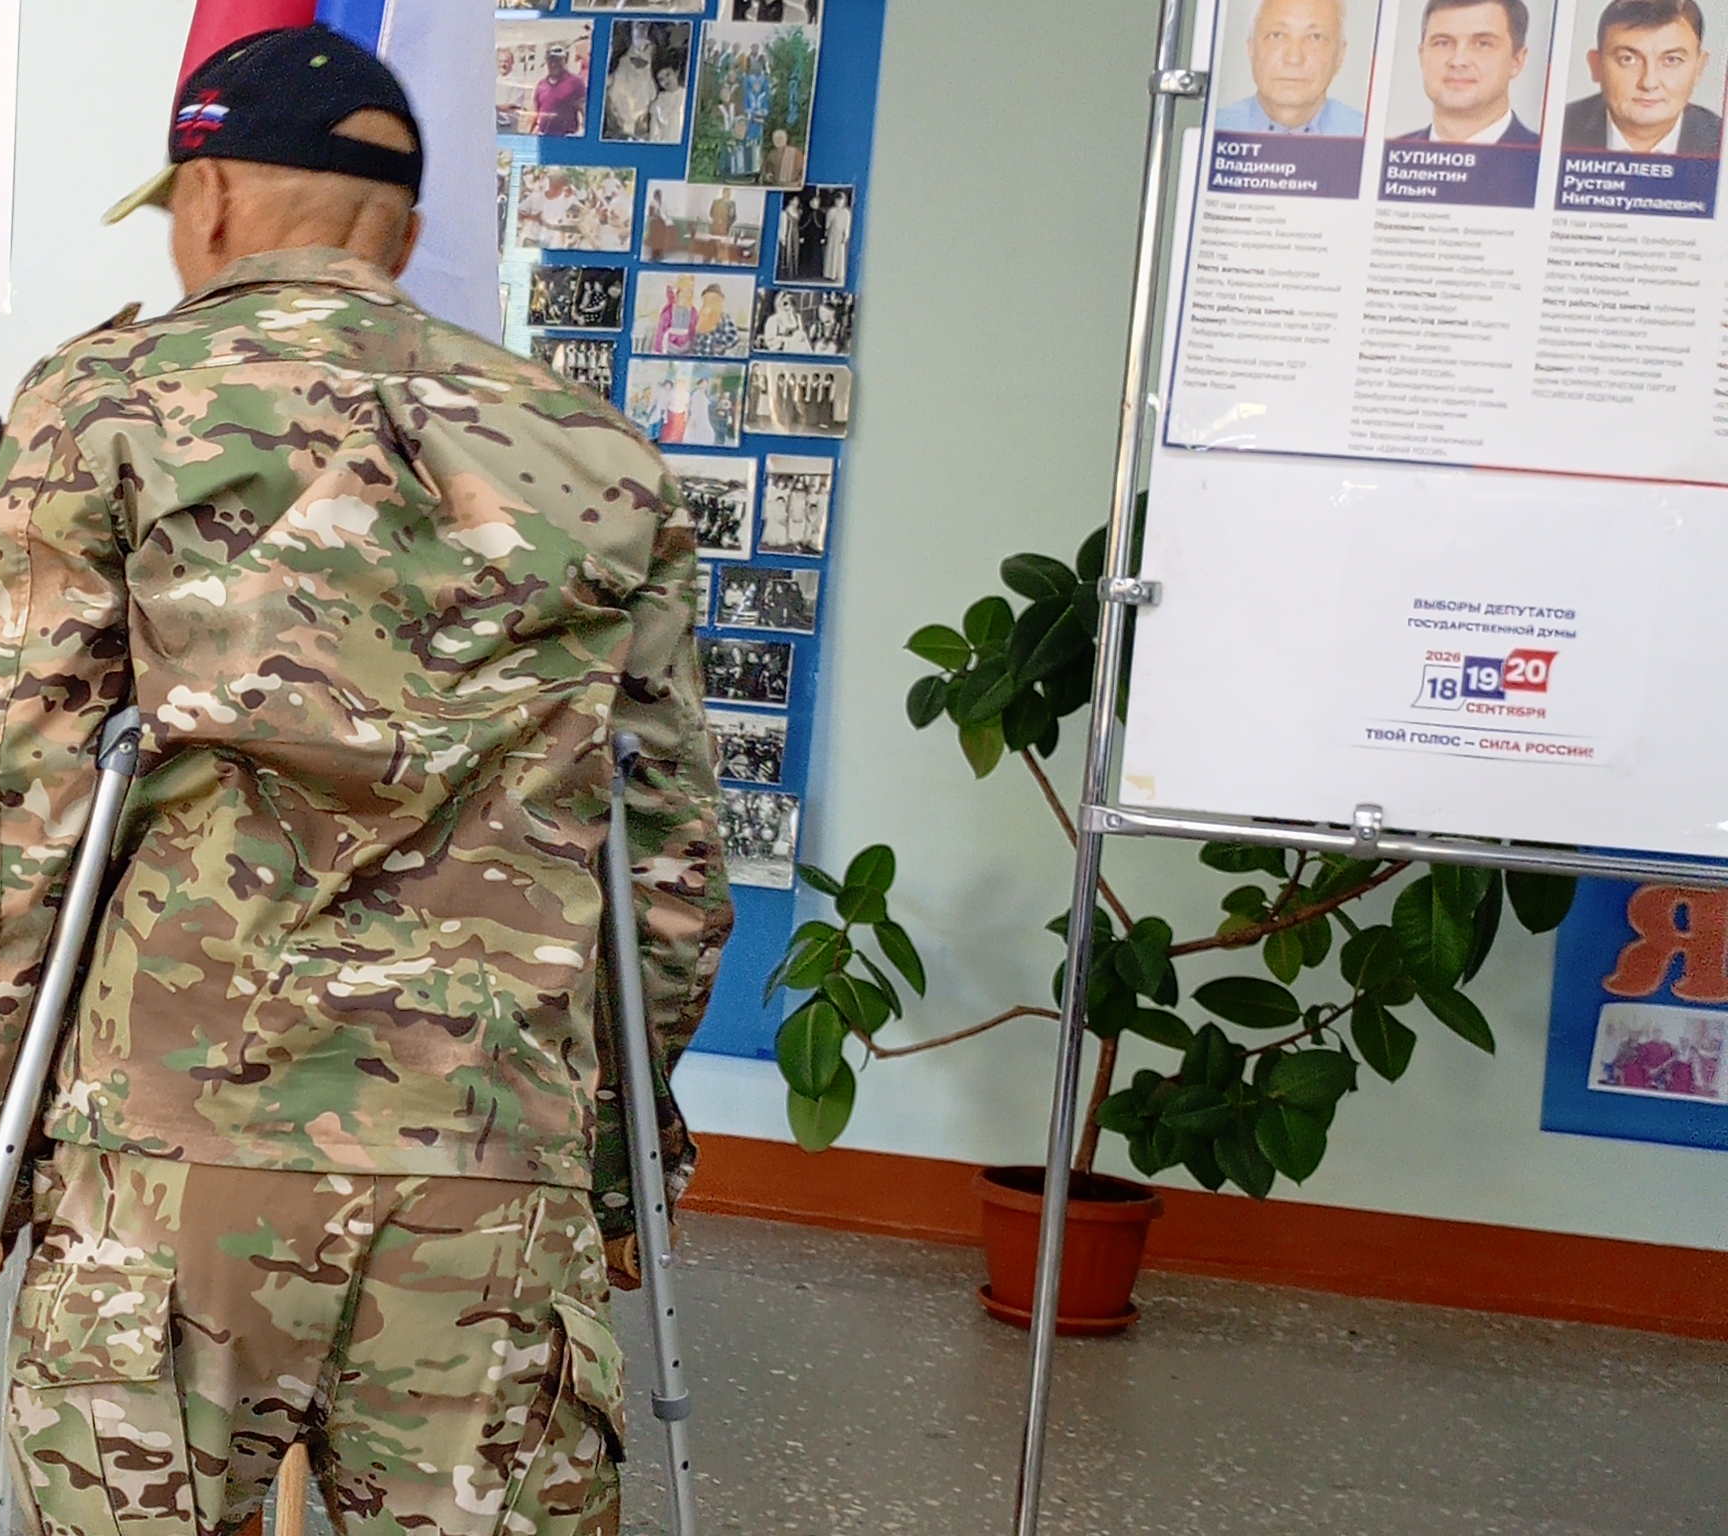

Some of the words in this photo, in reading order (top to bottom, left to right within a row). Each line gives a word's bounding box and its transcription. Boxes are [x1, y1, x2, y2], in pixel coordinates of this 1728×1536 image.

[1216, 142, 1262, 157] КОТТ
[1388, 150, 1477, 167] КУПИНОВ
[1215, 157, 1296, 176] Владимир
[1387, 166, 1468, 182] Валентин
[1565, 159, 1674, 178] МИНГАЛЕЕВ
[1212, 173, 1318, 191] Анатольевич
[1385, 182, 1437, 197] Ильич
[1563, 175, 1626, 192] Рустам
[1561, 191, 1706, 213] Нигматуллаевич
[1413, 598, 1481, 613] ВЫБОРЫ
[1484, 603, 1576, 620] ДЕПУТАТОВ
[1408, 617, 1534, 637] ГОСУДАРСТВЕННОЙ
[1536, 627, 1576, 639] ДУМЫ
[1425, 650, 1461, 663] 2026
[1427, 677, 1458, 701] 18
[1466, 666, 1499, 691] 19
[1505, 658, 1547, 684] 20
[1466, 702, 1546, 719] СЕНТЯБРЯ
[1366, 728, 1406, 743] ТВОЙ
[1410, 732, 1461, 747] ГОЛОС
[1479, 738, 1521, 753] СИЛА
[1525, 743, 1594, 759] РОССИИ!
[1602, 882, 1728, 1003] Я
